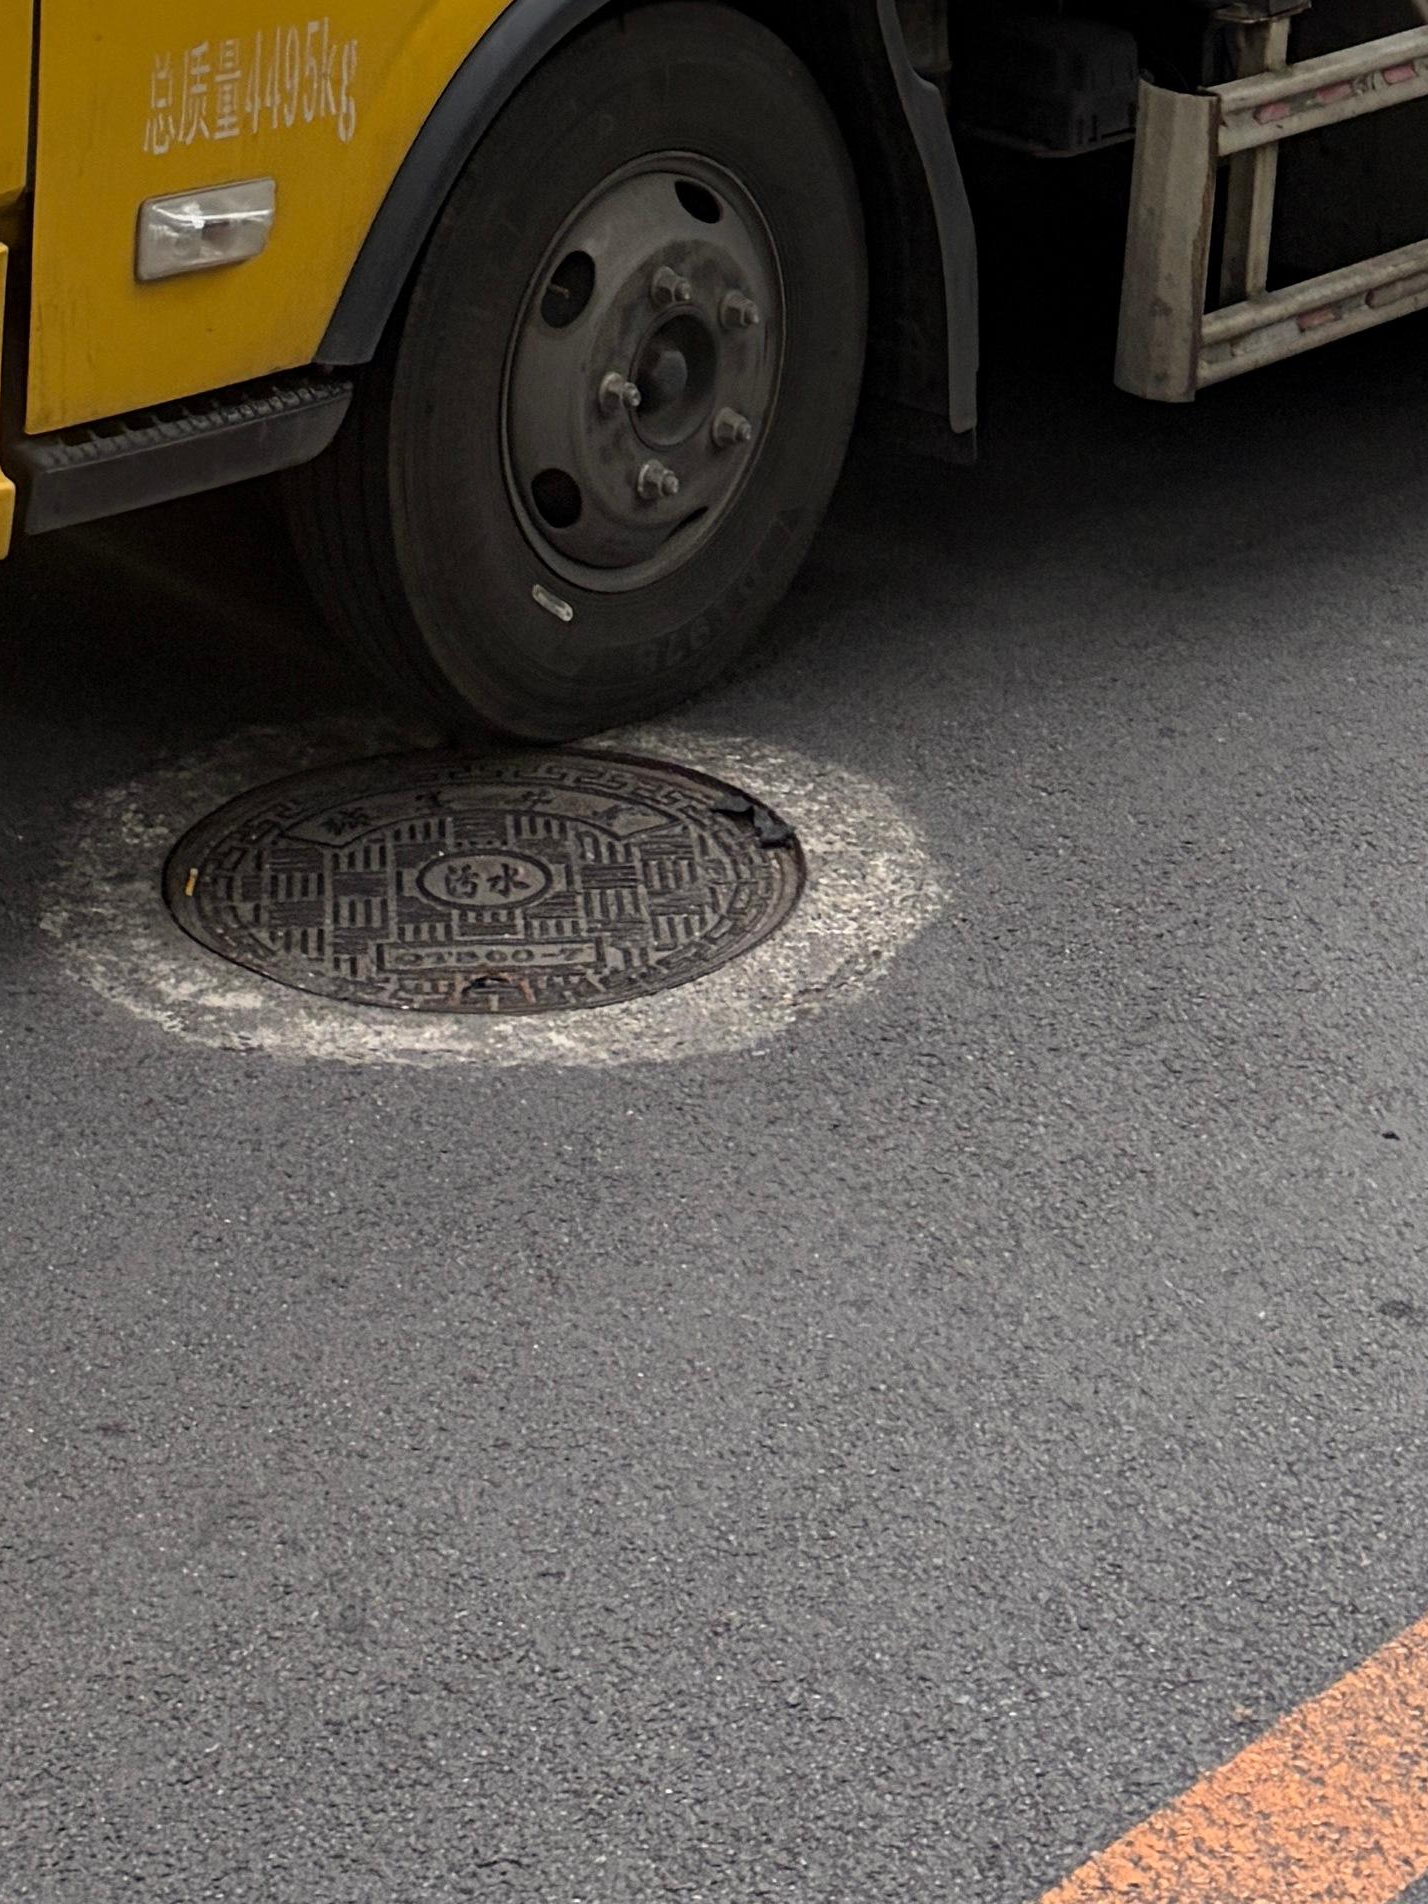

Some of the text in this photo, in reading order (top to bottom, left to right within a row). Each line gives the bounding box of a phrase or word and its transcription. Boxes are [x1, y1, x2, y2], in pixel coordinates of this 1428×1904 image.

[143, 16, 358, 156] 总质量4495kg
[444, 862, 531, 899] 污水
